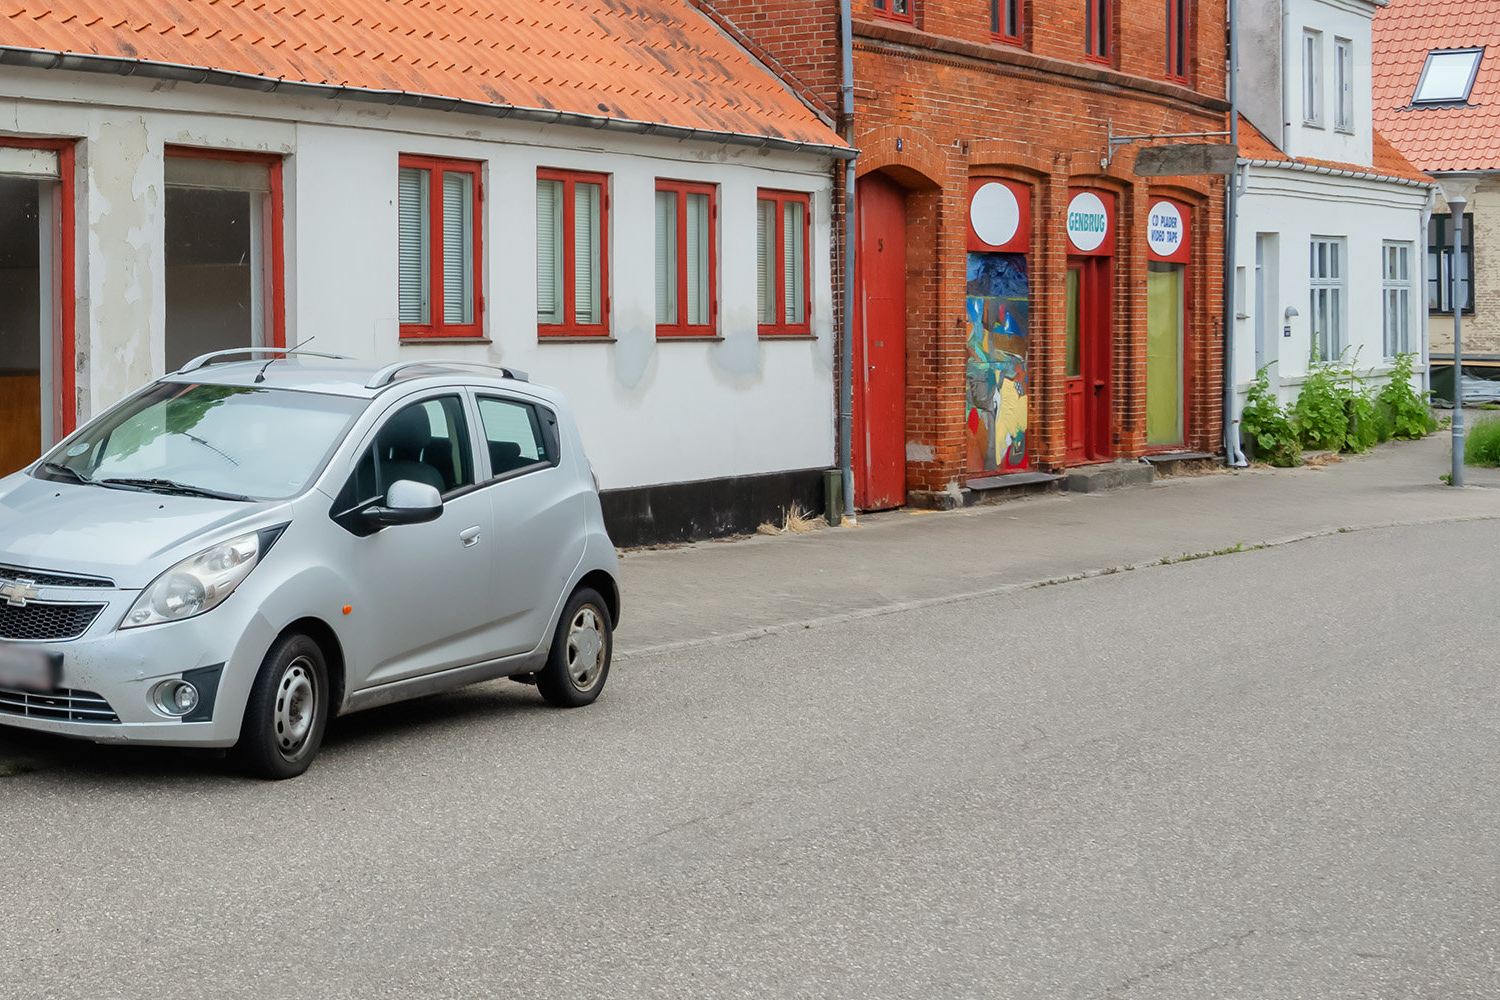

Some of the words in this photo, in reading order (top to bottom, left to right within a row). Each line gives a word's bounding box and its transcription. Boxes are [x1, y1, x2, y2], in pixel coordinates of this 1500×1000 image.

[1068, 212, 1105, 233] GENBRUG
[1152, 214, 1159, 226] CD
[1160, 215, 1177, 228] PLADER
[1151, 230, 1164, 242] VIDEO
[1167, 231, 1177, 243] TAPE
